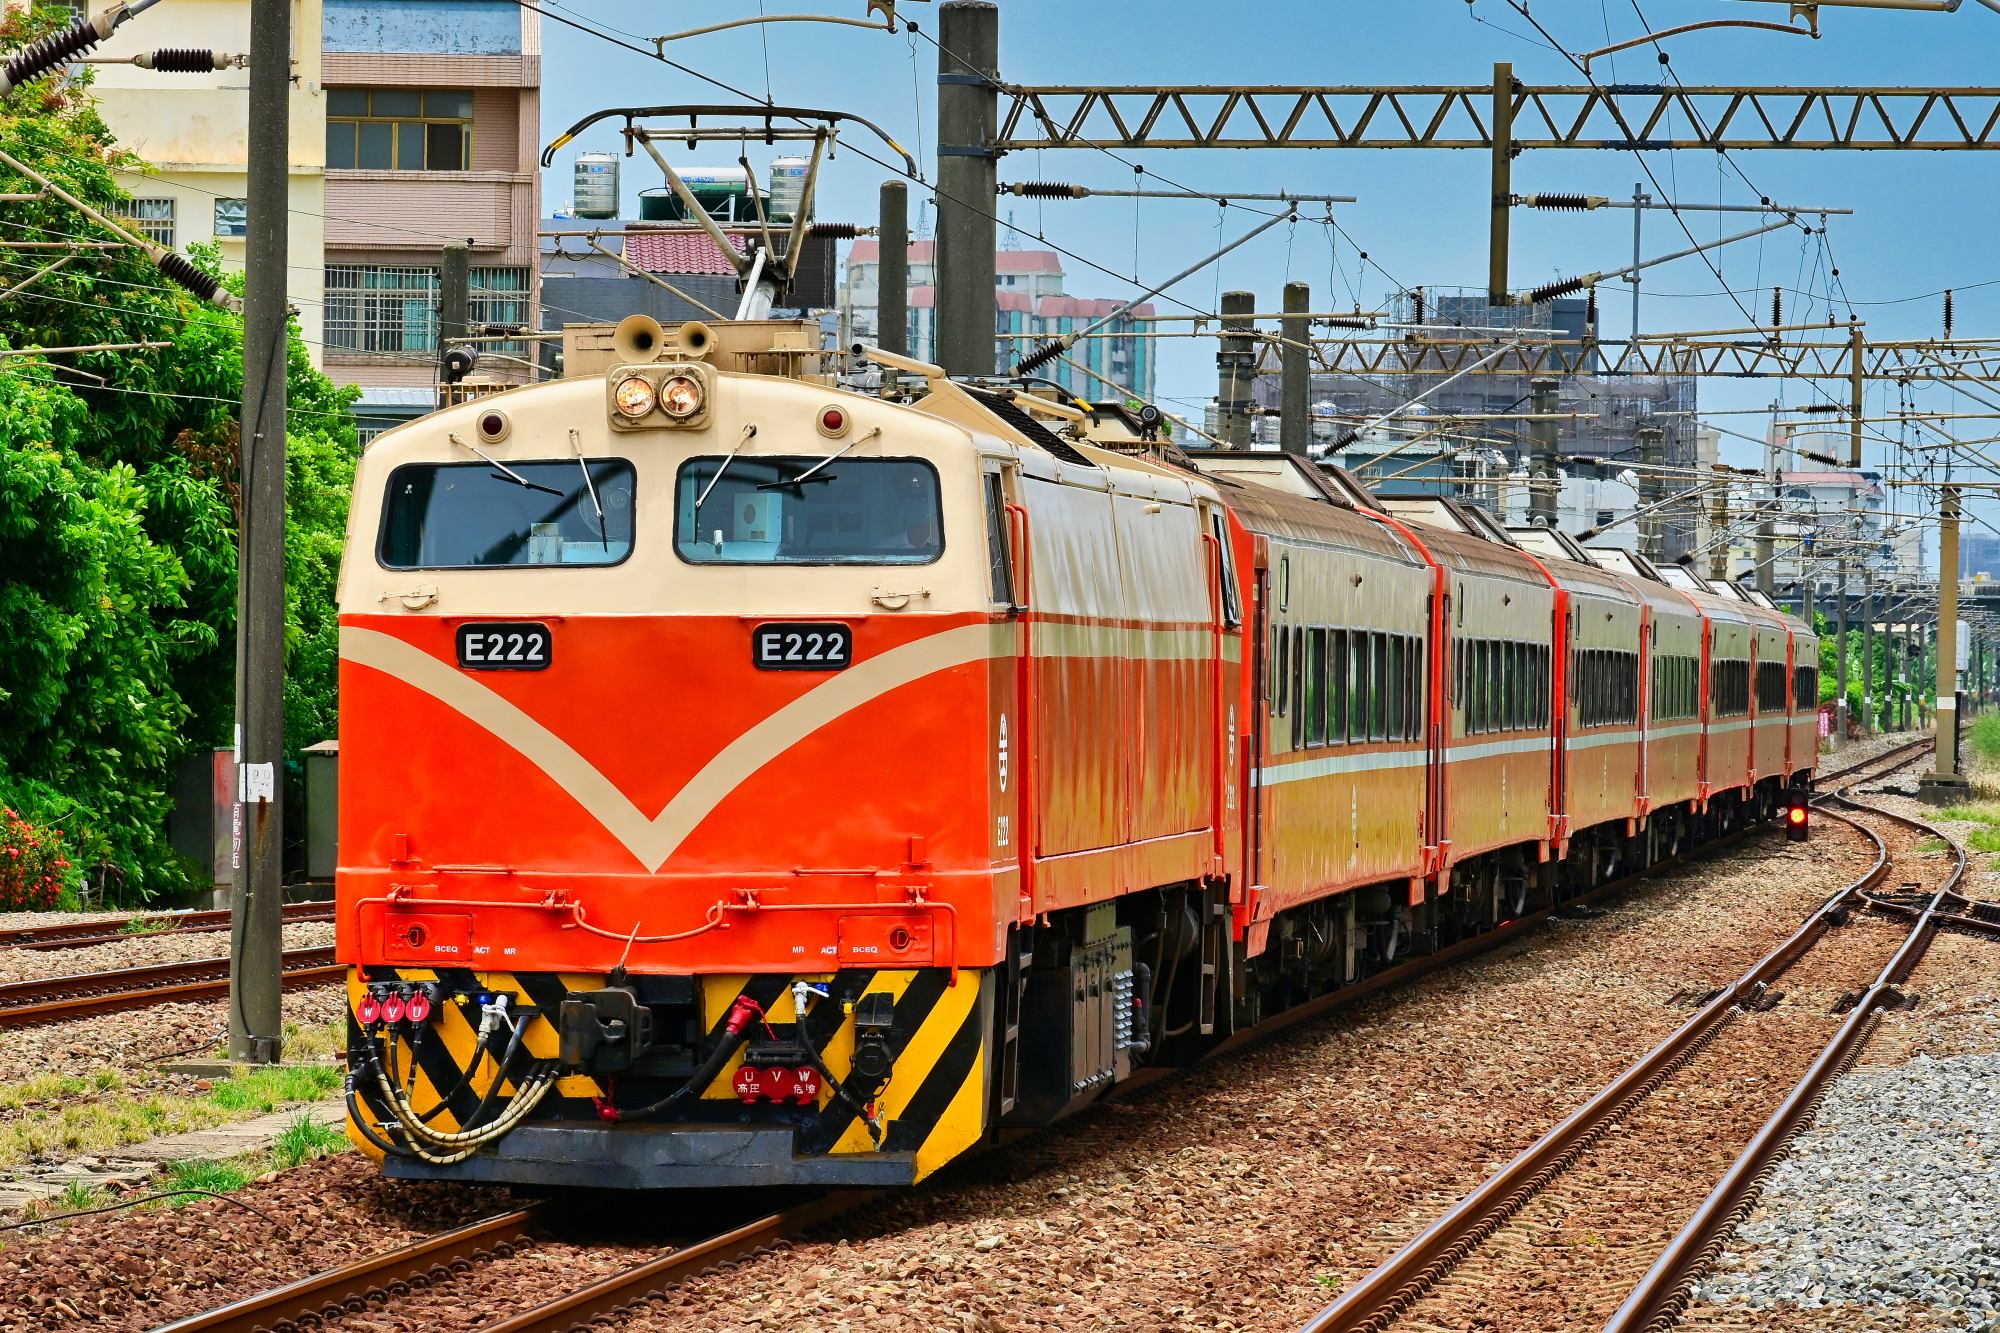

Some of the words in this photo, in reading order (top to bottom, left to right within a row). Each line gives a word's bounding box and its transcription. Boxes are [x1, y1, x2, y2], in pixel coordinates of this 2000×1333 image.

[465, 633, 544, 661] E222
[761, 632, 844, 661] E222
[435, 945, 458, 953] BCEQ
[474, 946, 490, 954] ACT
[504, 947, 516, 955] MR
[792, 946, 804, 954] MR
[820, 946, 837, 954] ACT
[852, 946, 878, 954] BCEQ
[364, 1007, 373, 1018] W
[389, 1007, 397, 1018] V
[413, 1006, 421, 1018] U
[744, 1071, 754, 1082] U
[772, 1071, 782, 1082] V
[798, 1071, 810, 1082] W
